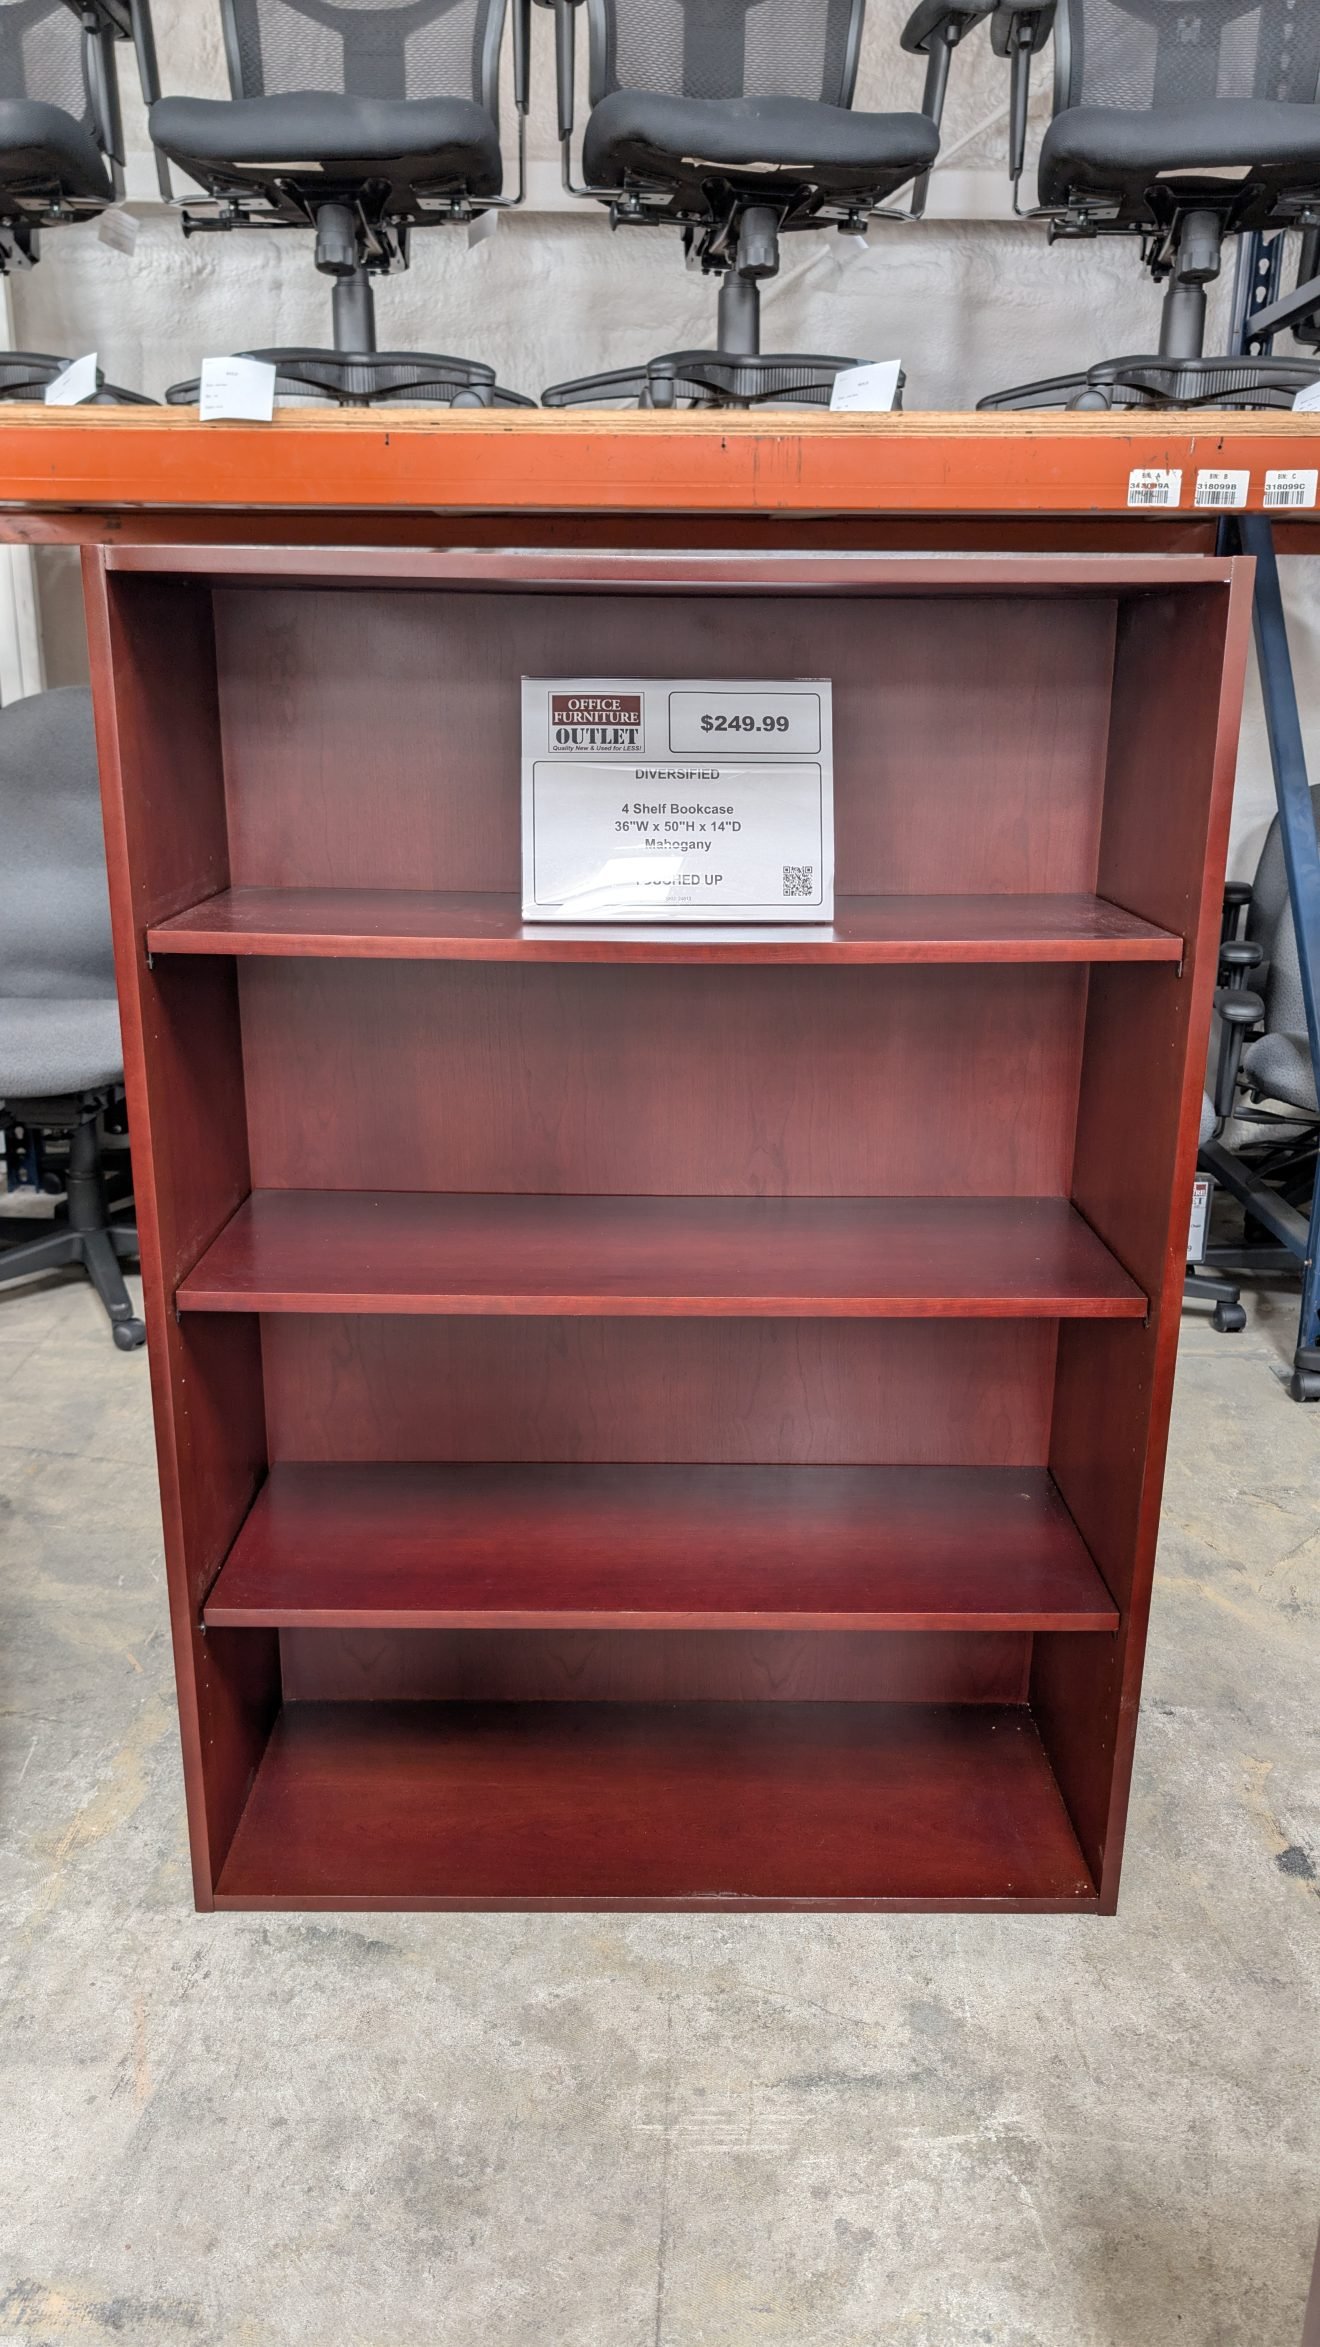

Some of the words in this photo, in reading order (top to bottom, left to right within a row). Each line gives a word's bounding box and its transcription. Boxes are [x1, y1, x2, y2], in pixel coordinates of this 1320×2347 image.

[568, 698, 621, 711] OFFICE
[553, 711, 640, 723] FURNITURE
[700, 713, 789, 733] $249.99
[555, 728, 639, 745] OUTLET
[635, 769, 720, 780] DIVERSIFIED
[621, 803, 629, 814] 4
[633, 803, 667, 815] Shelf
[670, 803, 734, 815] Bookcase
[614, 821, 649, 832] 36"W
[652, 823, 660, 832] x
[664, 821, 695, 832] 50"H
[699, 823, 707, 832] x
[710, 821, 742, 832] 14"D
[645, 838, 712, 852] Mahogany
[704, 874, 723, 885] UP
